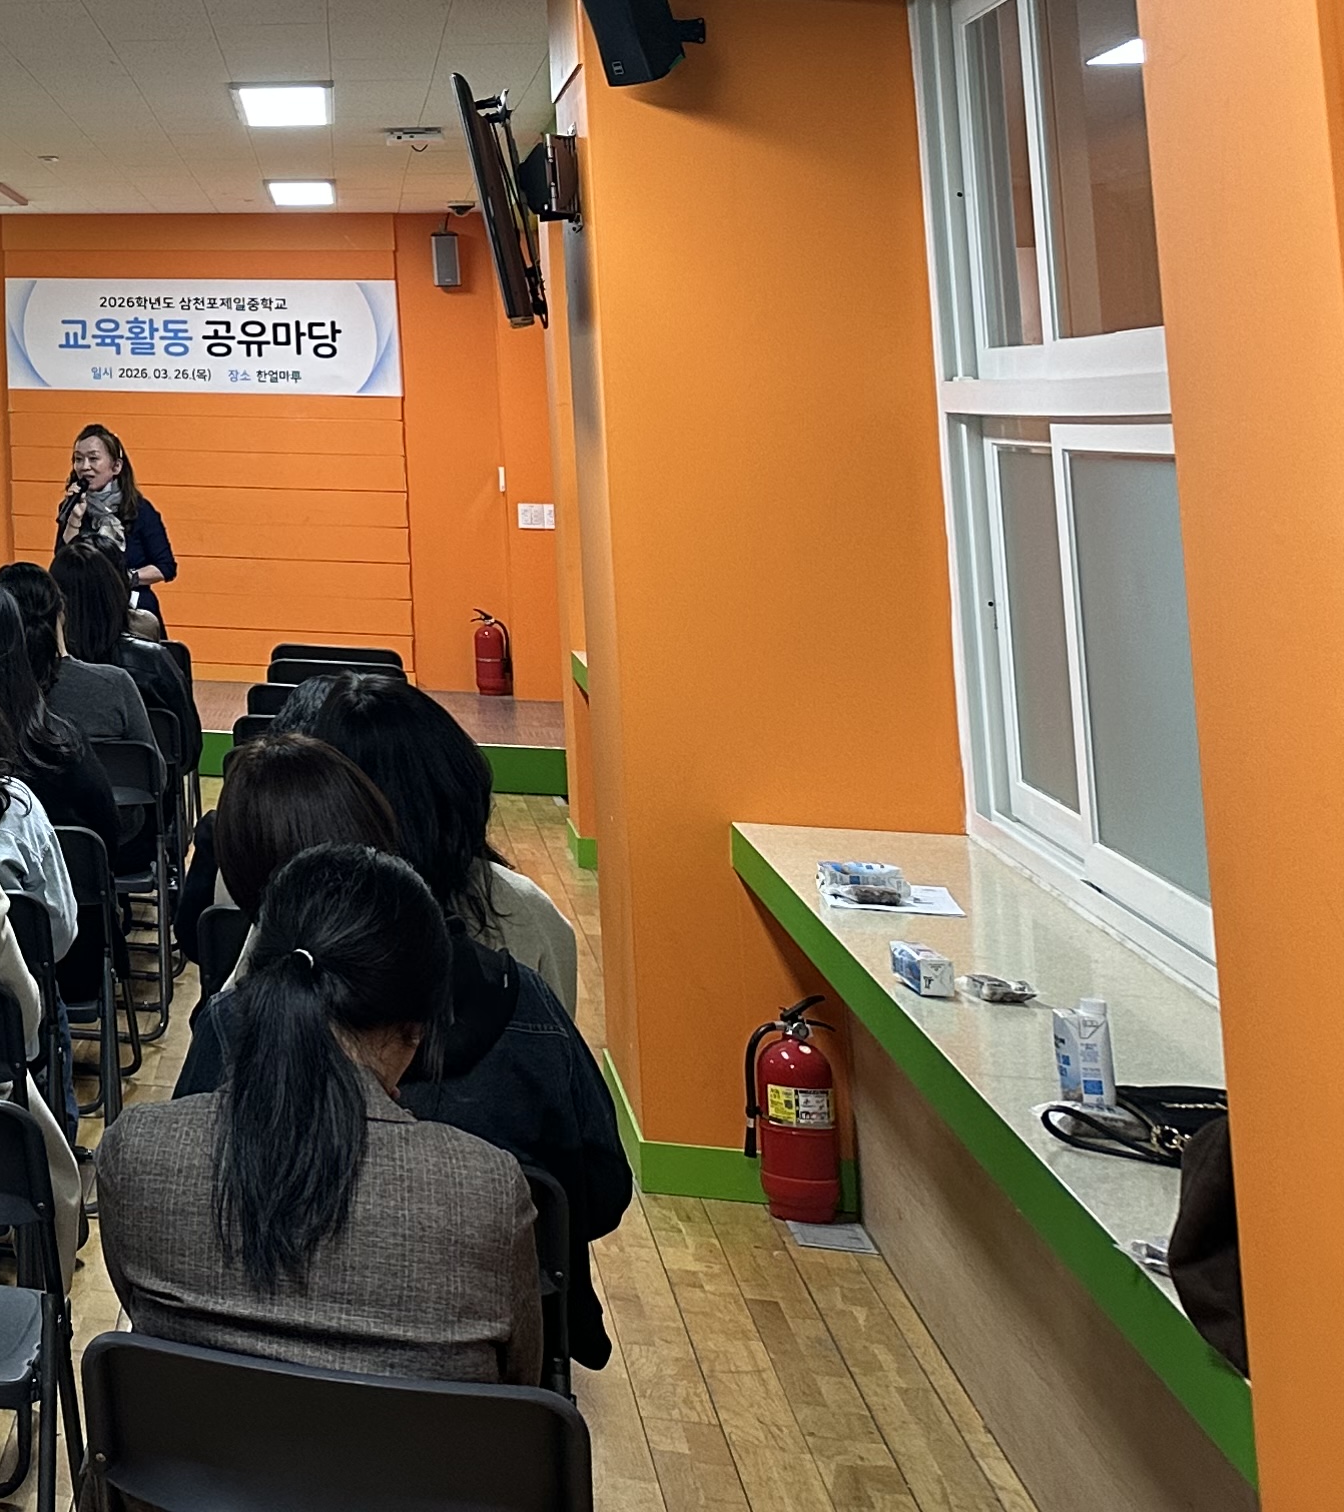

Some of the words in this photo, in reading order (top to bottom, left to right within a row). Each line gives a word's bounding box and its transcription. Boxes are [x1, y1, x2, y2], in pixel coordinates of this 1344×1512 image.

[99, 296, 175, 311] 2026학년도
[178, 296, 288, 312] 삼천포제일중학교
[58, 316, 194, 357] 교육활동
[201, 319, 343, 359] 공유마당
[91, 366, 113, 380] 일시
[228, 369, 252, 383] 장소
[256, 369, 302, 384] 한얼마루
